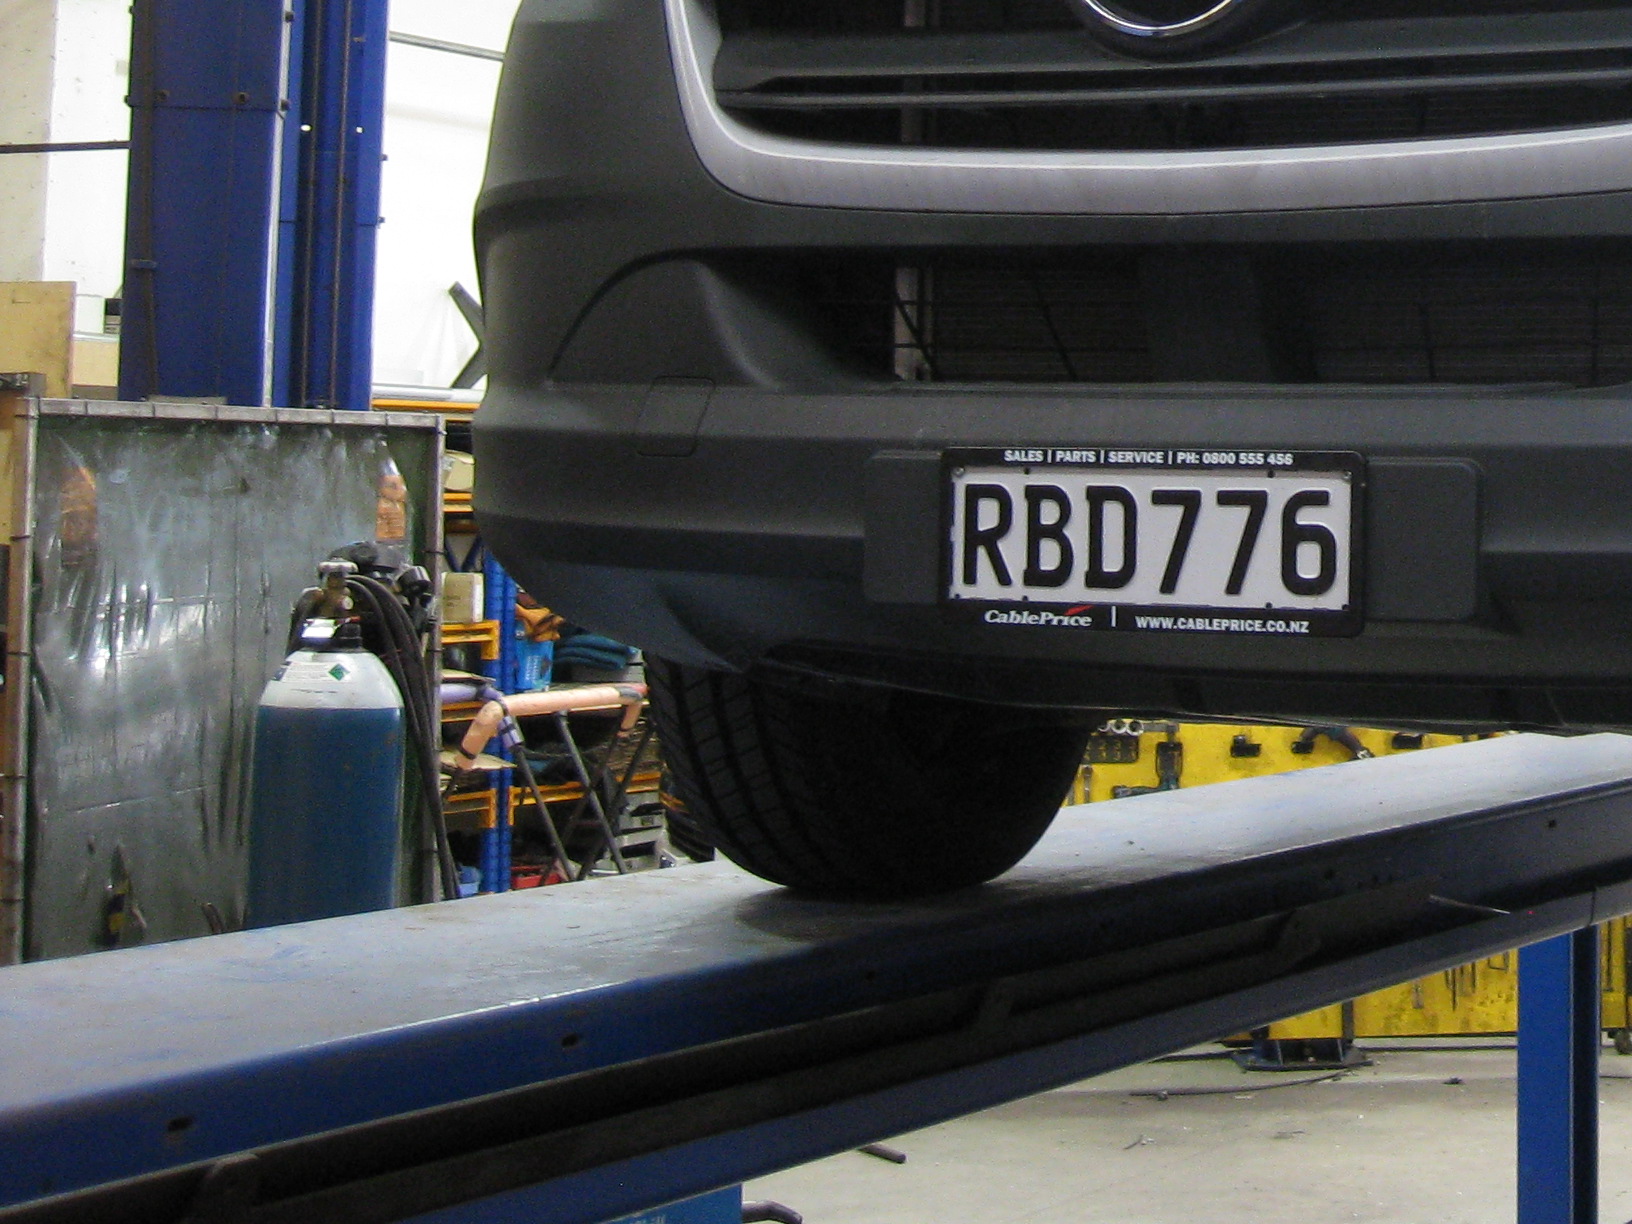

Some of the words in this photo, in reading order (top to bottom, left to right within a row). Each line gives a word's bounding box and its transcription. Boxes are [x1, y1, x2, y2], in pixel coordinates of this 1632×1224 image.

[1004, 449, 1045, 463] SALES
[1055, 450, 1096, 464] PARTS
[1108, 451, 1164, 464] SERVICE
[1176, 451, 1200, 465] PH:
[1202, 452, 1236, 465] 0800
[1239, 452, 1265, 466] 555
[1267, 452, 1294, 466] 456
[961, 482, 1338, 596] RBD776
[984, 608, 1093, 627] CablePrice
[1135, 614, 1310, 634] WWW.CABLEPRICE.CO.NZ
